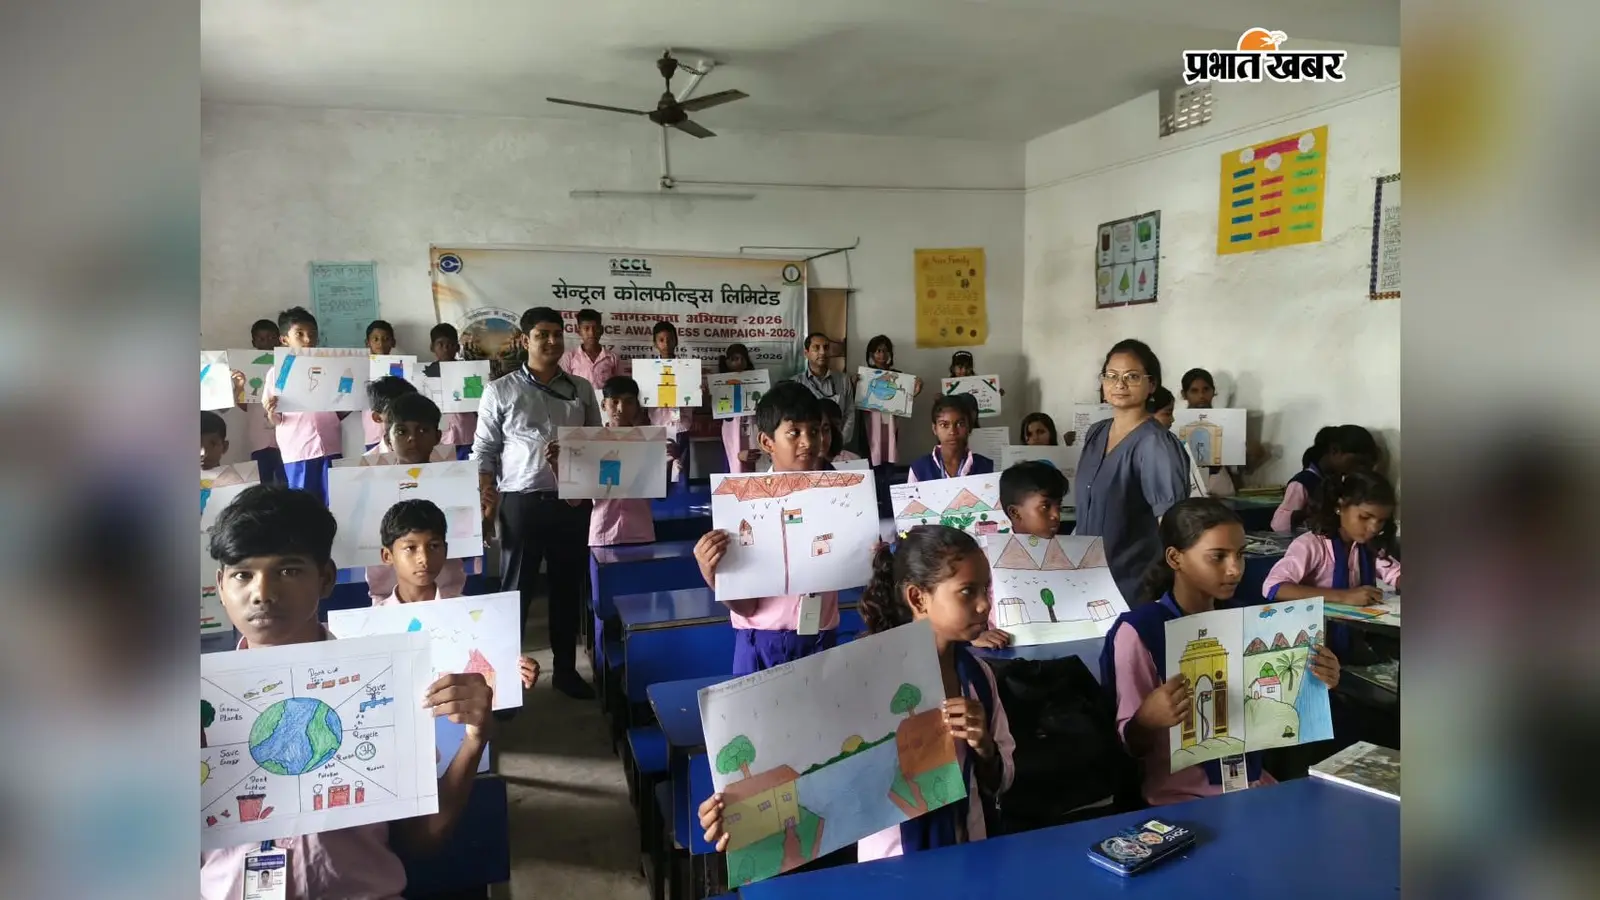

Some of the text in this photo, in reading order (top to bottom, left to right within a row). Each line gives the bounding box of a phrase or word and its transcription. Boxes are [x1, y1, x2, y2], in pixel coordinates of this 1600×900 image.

[620, 258, 652, 270] CCL
[552, 277, 780, 308] सेन्ट्रल कोलफील्ड्स लिमिटेड
[686, 313, 738, 324] अभियान
[703, 328, 796, 338] CAMPAIGN-2026
[219, 749, 240, 758] Save
